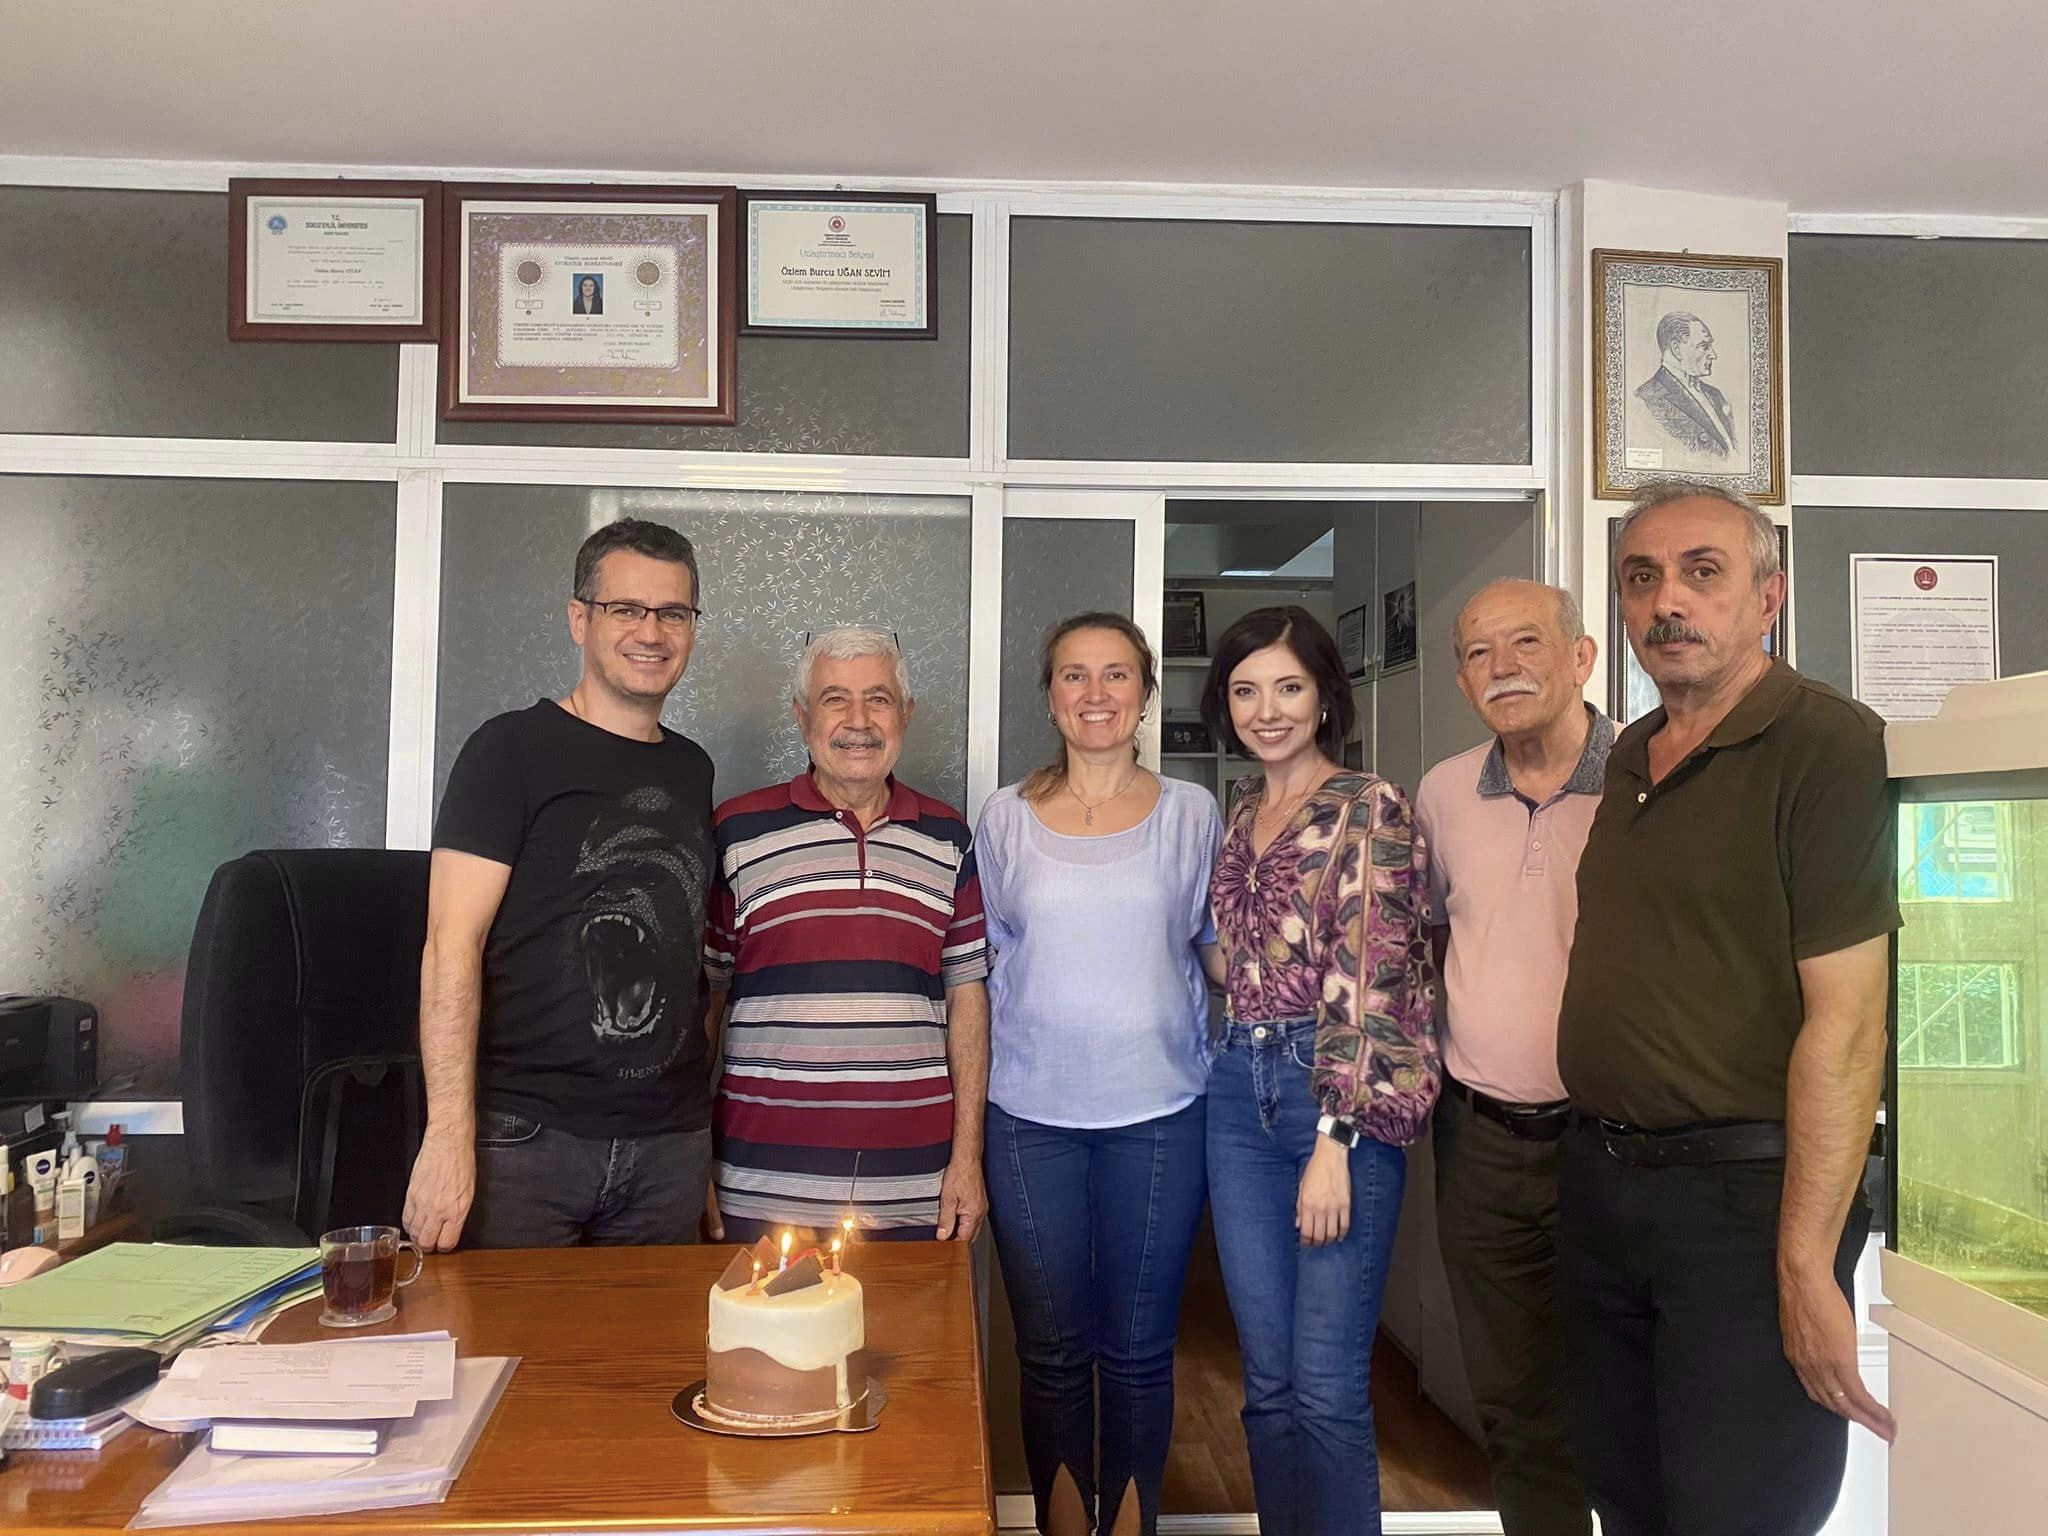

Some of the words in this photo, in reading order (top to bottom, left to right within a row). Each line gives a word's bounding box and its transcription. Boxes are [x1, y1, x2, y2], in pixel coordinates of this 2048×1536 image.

[781, 266, 807, 277] Özlem
[809, 267, 835, 277] Burcu
[837, 267, 862, 278] UĞAN
[864, 267, 891, 278] SEVİM
